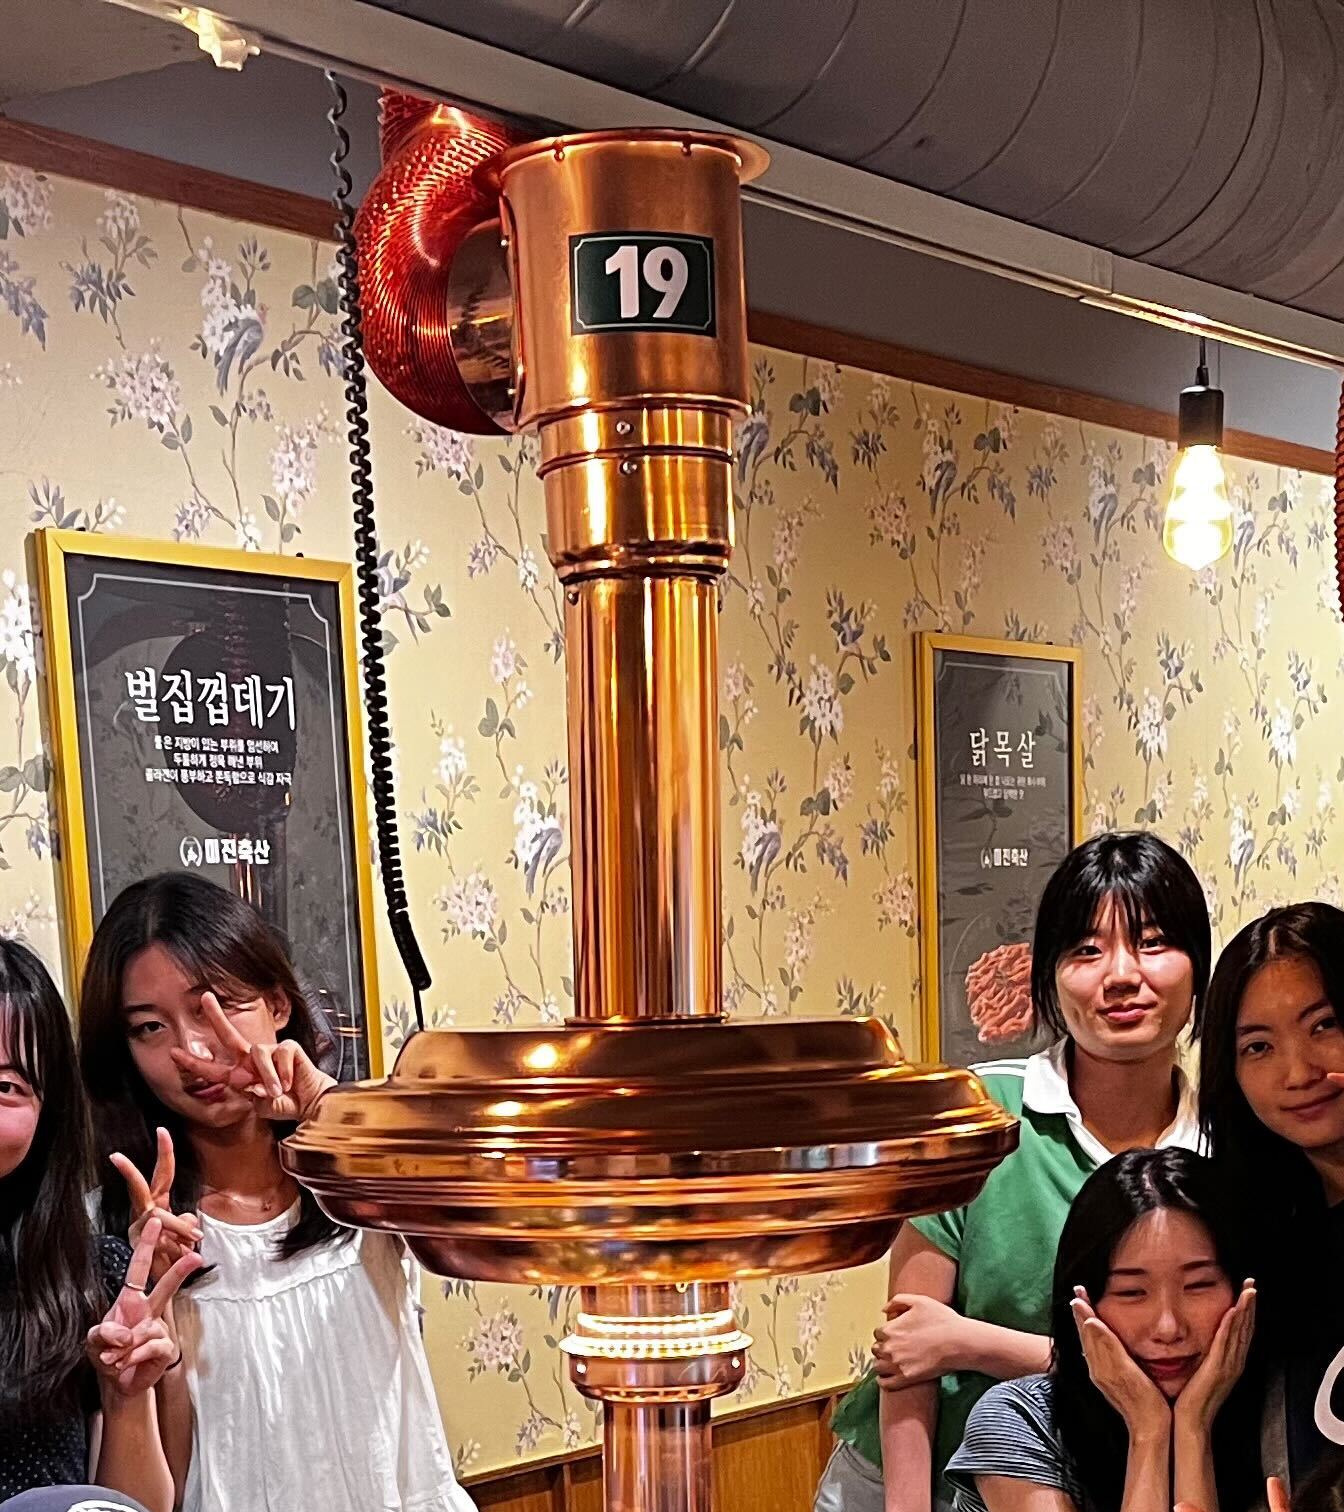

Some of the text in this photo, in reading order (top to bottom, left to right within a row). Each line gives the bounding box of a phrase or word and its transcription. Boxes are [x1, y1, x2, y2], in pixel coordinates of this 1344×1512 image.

[605, 245, 689, 319] 19
[124, 667, 296, 731] 벌집껍데기
[174, 736, 200, 751] 지방이
[969, 727, 1037, 769] 닭목살
[204, 838, 271, 865] 미진축산
